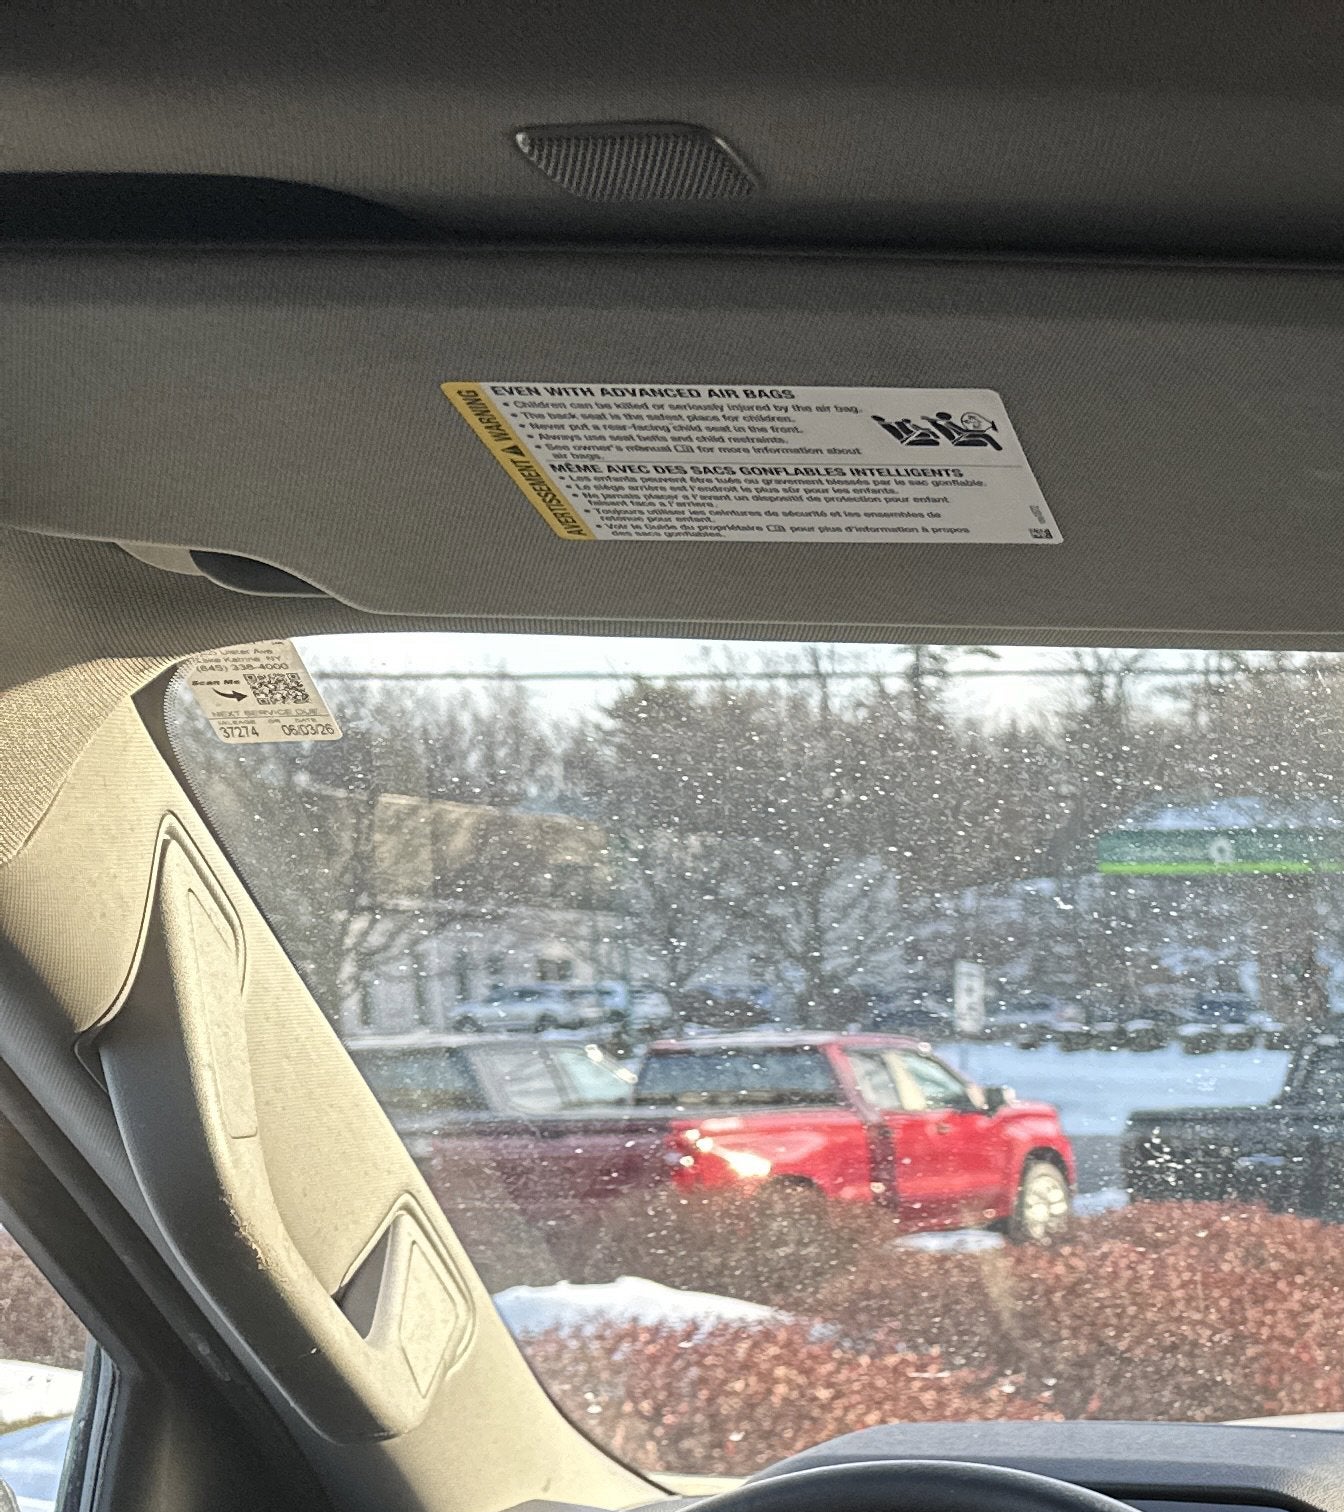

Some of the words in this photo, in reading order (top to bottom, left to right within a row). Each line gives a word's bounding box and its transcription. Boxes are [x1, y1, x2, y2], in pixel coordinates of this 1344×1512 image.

[490, 386, 541, 397] EVEN
[544, 387, 595, 397] WITH
[600, 387, 701, 399] ADVANCED
[707, 388, 740, 399] AIR
[743, 389, 796, 400] BAGS
[513, 400, 568, 410] Children
[572, 402, 593, 411] can
[792, 404, 813, 413] the
[457, 389, 513, 442] WARNING
[521, 412, 545, 421] The
[550, 462, 603, 475] MÊME
[607, 465, 651, 475] AVEC
[653, 465, 688, 476] DES
[690, 466, 737, 476] SACS
[740, 466, 847, 478] GONFLABLES
[850, 467, 964, 478] INTELLIGENTS
[219, 725, 260, 739] 37274
